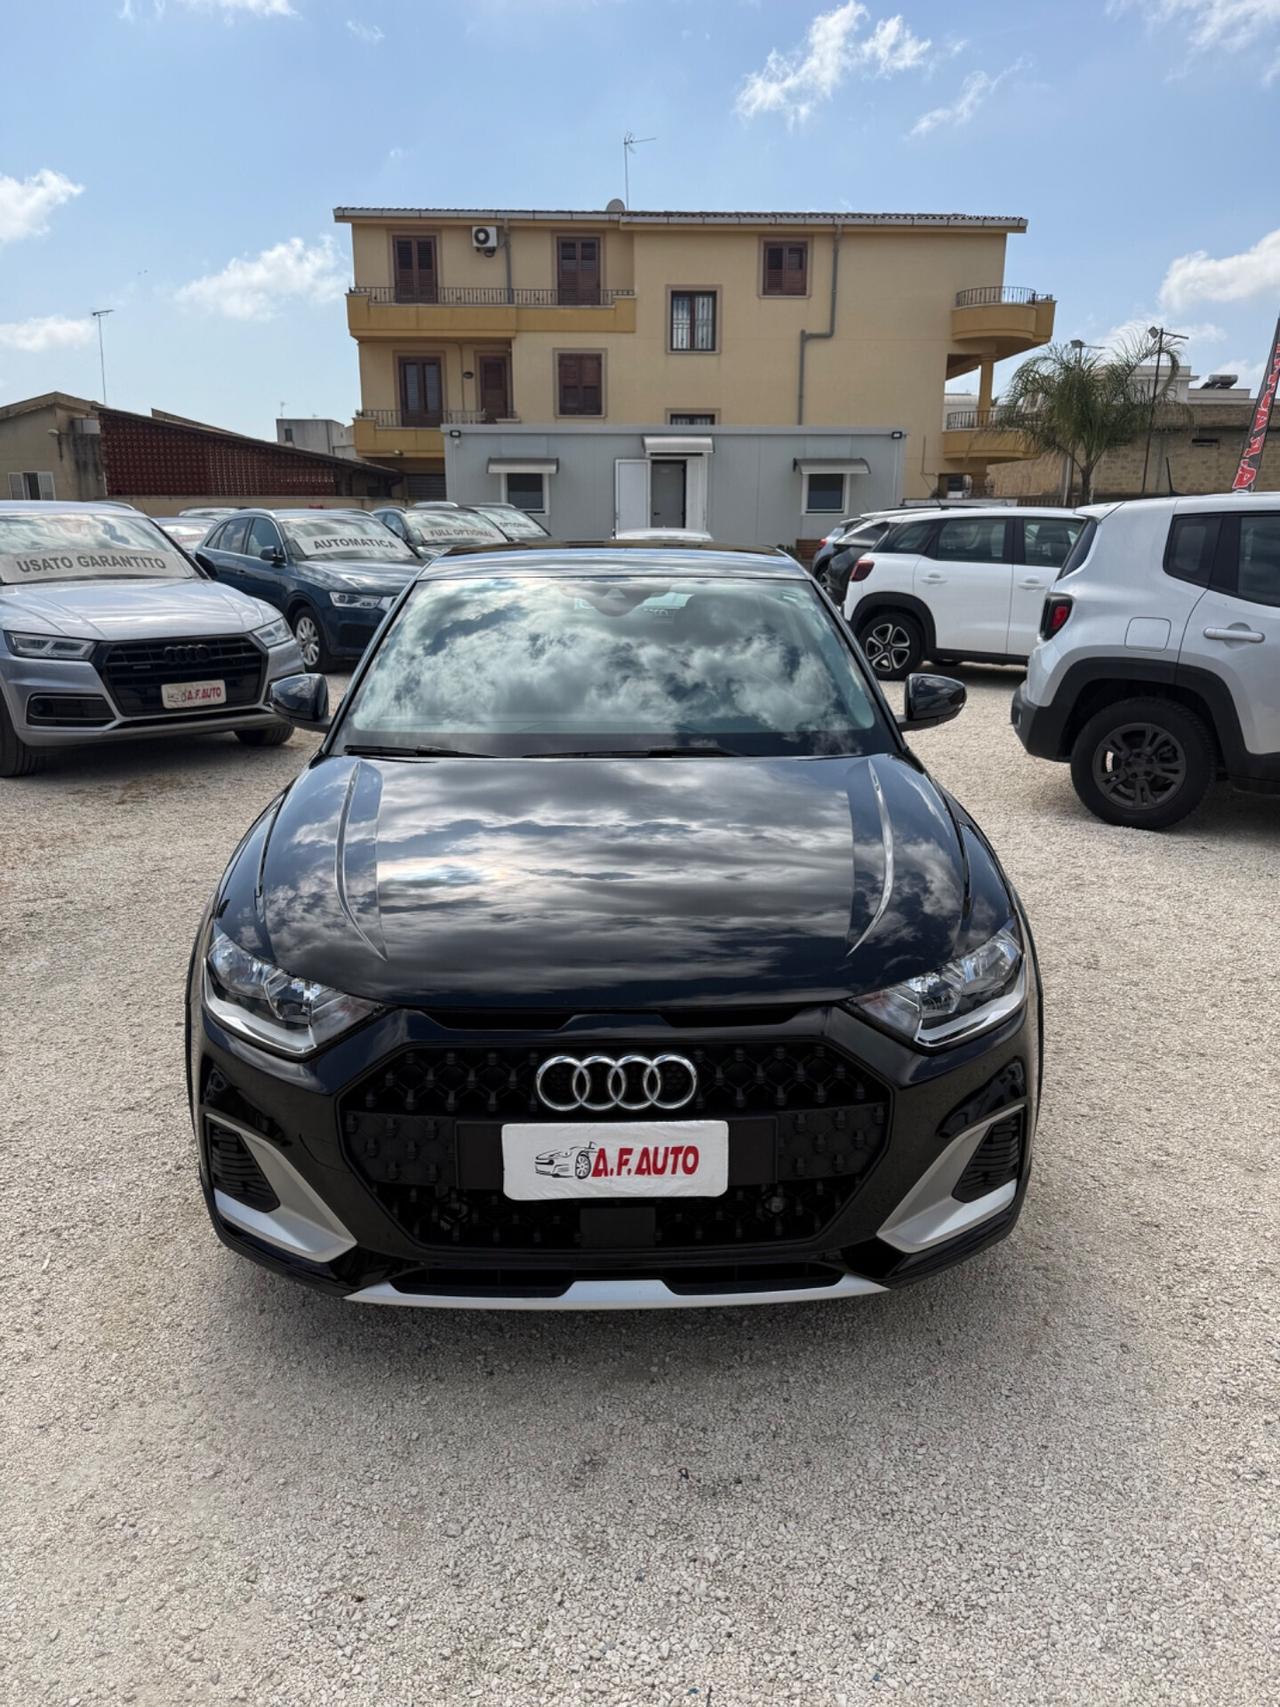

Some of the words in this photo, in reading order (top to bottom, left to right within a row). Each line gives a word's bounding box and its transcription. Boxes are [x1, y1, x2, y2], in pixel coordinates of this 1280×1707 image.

[430, 529, 452, 537] FULL
[453, 528, 495, 538] OPTIONAL
[313, 538, 398, 549] AUTOMATICA
[16, 556, 74, 573] USATO
[76, 555, 167, 569] GARANTITO
